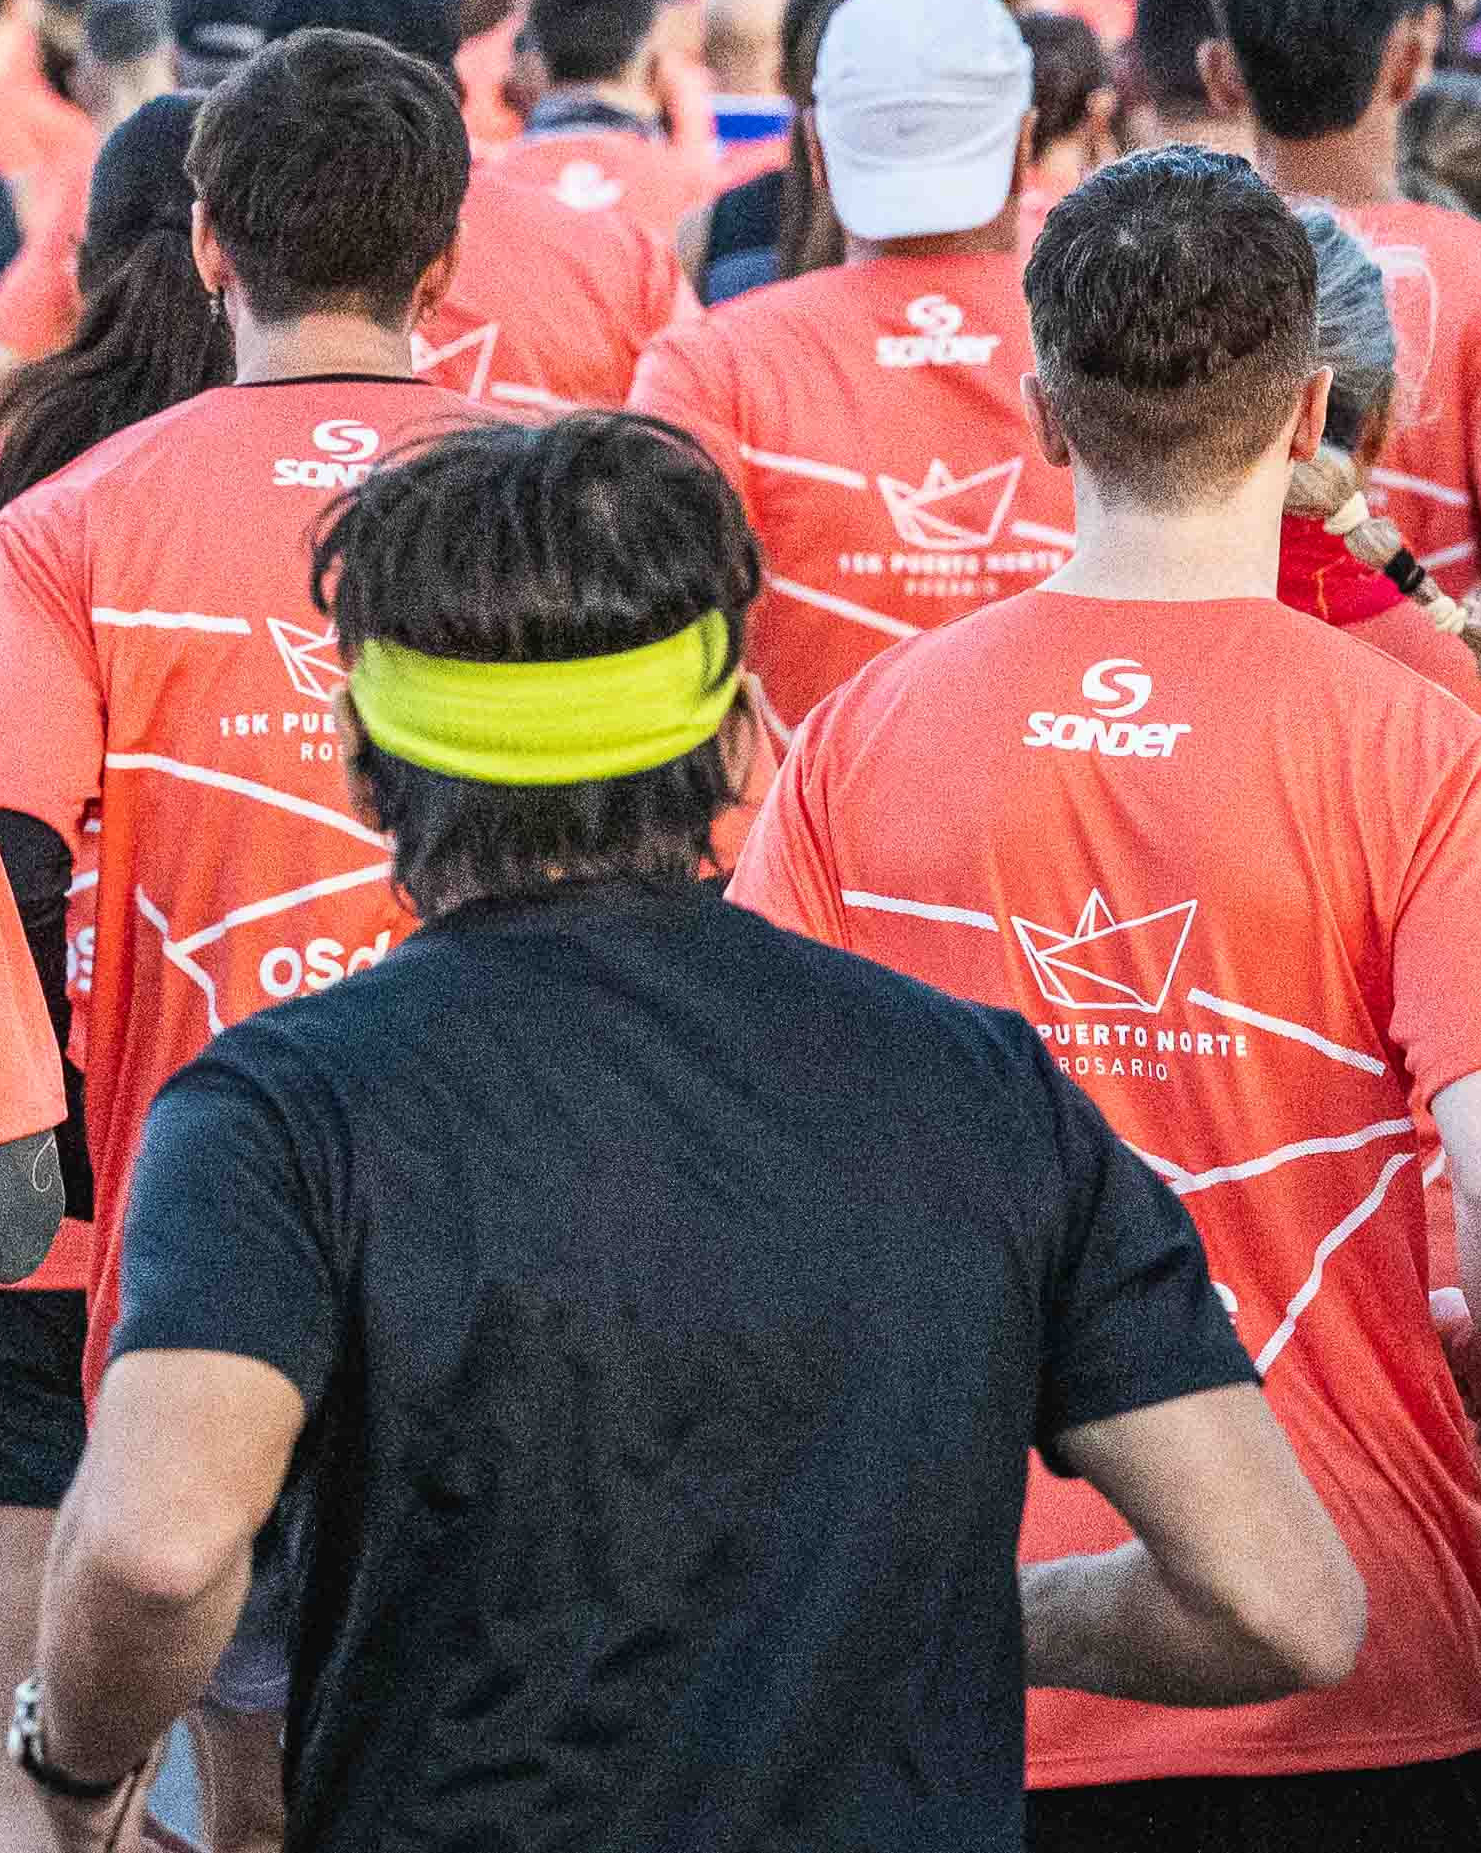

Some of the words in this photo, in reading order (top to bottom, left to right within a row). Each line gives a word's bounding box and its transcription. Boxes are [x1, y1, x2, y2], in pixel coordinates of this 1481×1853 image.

[220, 714, 269, 736] 15K
[1156, 1030, 1248, 1057] NORTE
[1057, 1057, 1168, 1081] ROSARIO
